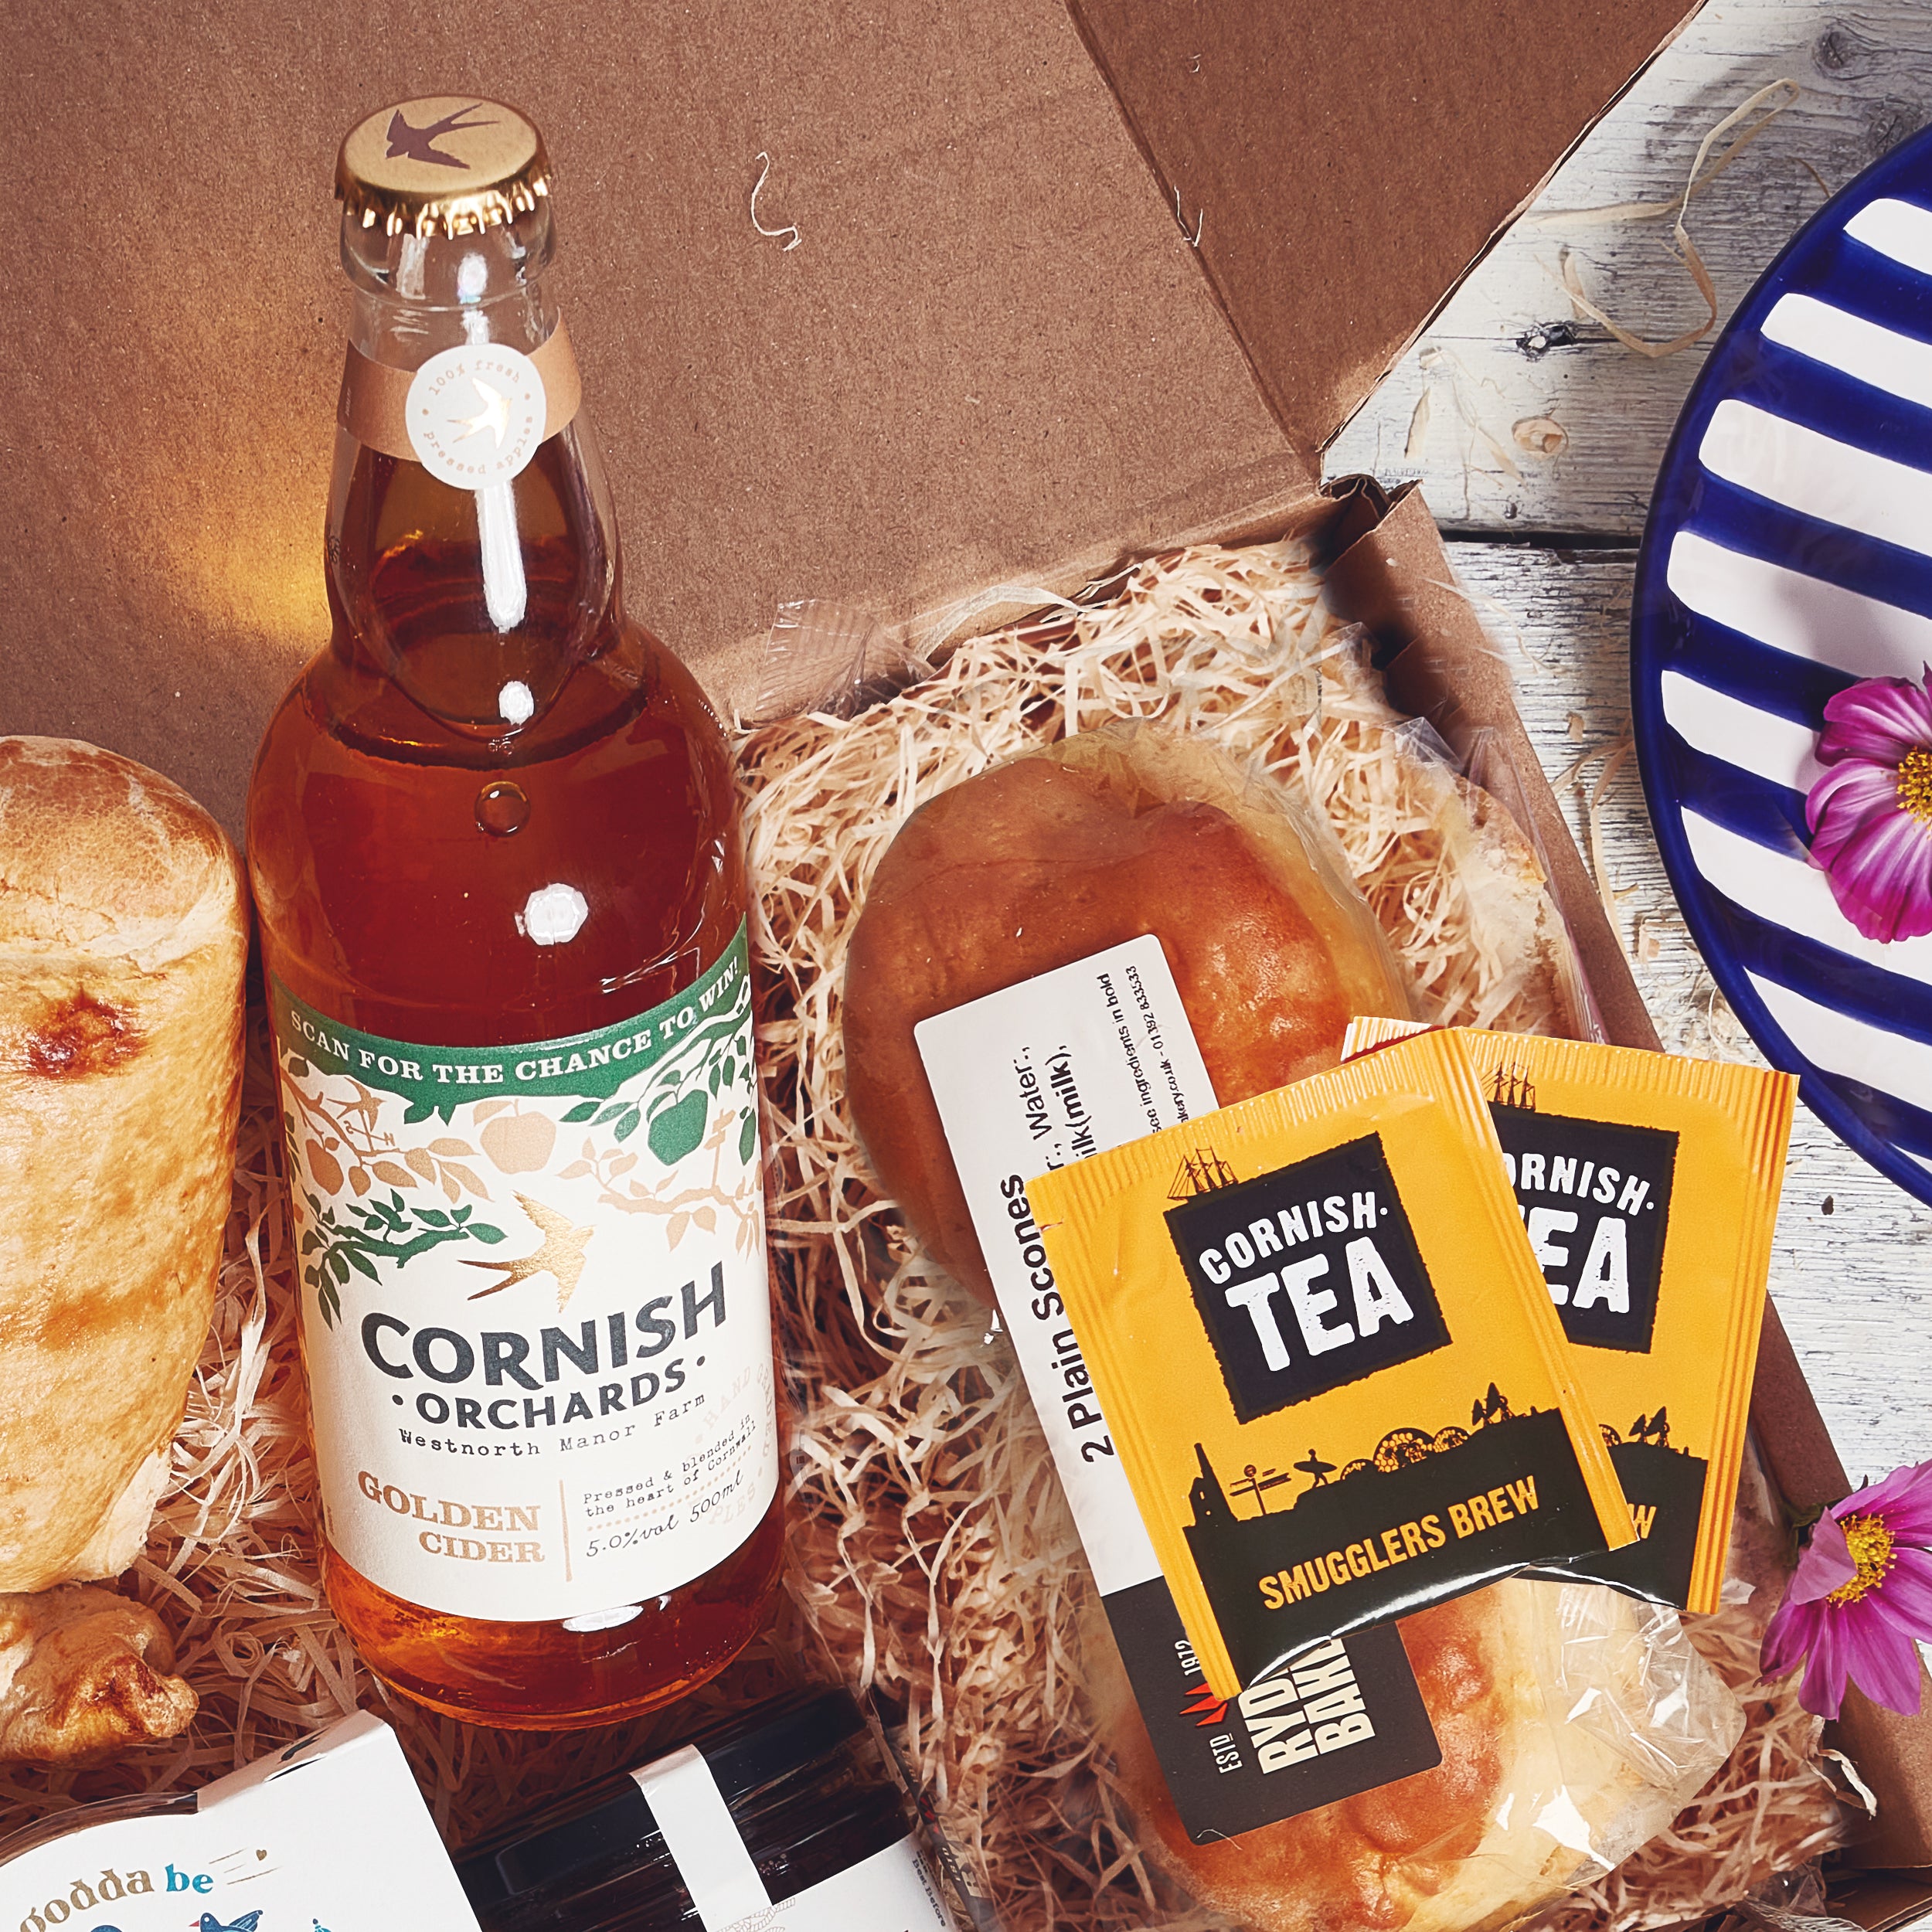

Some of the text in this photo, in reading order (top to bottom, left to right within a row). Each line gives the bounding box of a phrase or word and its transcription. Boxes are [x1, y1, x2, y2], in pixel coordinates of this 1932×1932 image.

[429, 360, 519, 396] 100% fresh
[423, 416, 532, 474] pressed apples
[291, 957, 739, 1084] SCAN FOR THE CHANCE TO WIN!
[1096, 973, 1119, 1008] bold
[1112, 1009, 1124, 1025] in
[1125, 965, 1150, 1010] 833533
[1118, 1026, 1153, 1107] ingredients
[1143, 1012, 1164, 1049] 01392
[1045, 1045, 1097, 1159] ilk(milk),
[1518, 1205, 1629, 1313] EA
[361, 1262, 726, 1390] CORNISH
[1000, 1174, 1114, 1462] 2 Plain Scones
[1225, 1236, 1413, 1371] TEA
[400, 1394, 705, 1455] Westnorth Manor Farm
[417, 1358, 686, 1430] ORCHARDS
[583, 1414, 750, 1504] Pressed & blended in
[587, 1420, 756, 1517] the heart of Cornwall
[359, 1470, 539, 1532] GOLDEN
[690, 1470, 743, 1522] 500ml
[419, 1532, 545, 1563] CIDER
[1259, 1514, 1446, 1610] SMUGGLERS
[1447, 1475, 1539, 1539] BREW
[1174, 1640, 1243, 1774] ESTD 1972
[1238, 1668, 1318, 1774] RYD
[165, 1863, 213, 1893] be
[912, 1859, 927, 1888] Best
[925, 1885, 946, 1927] Before
